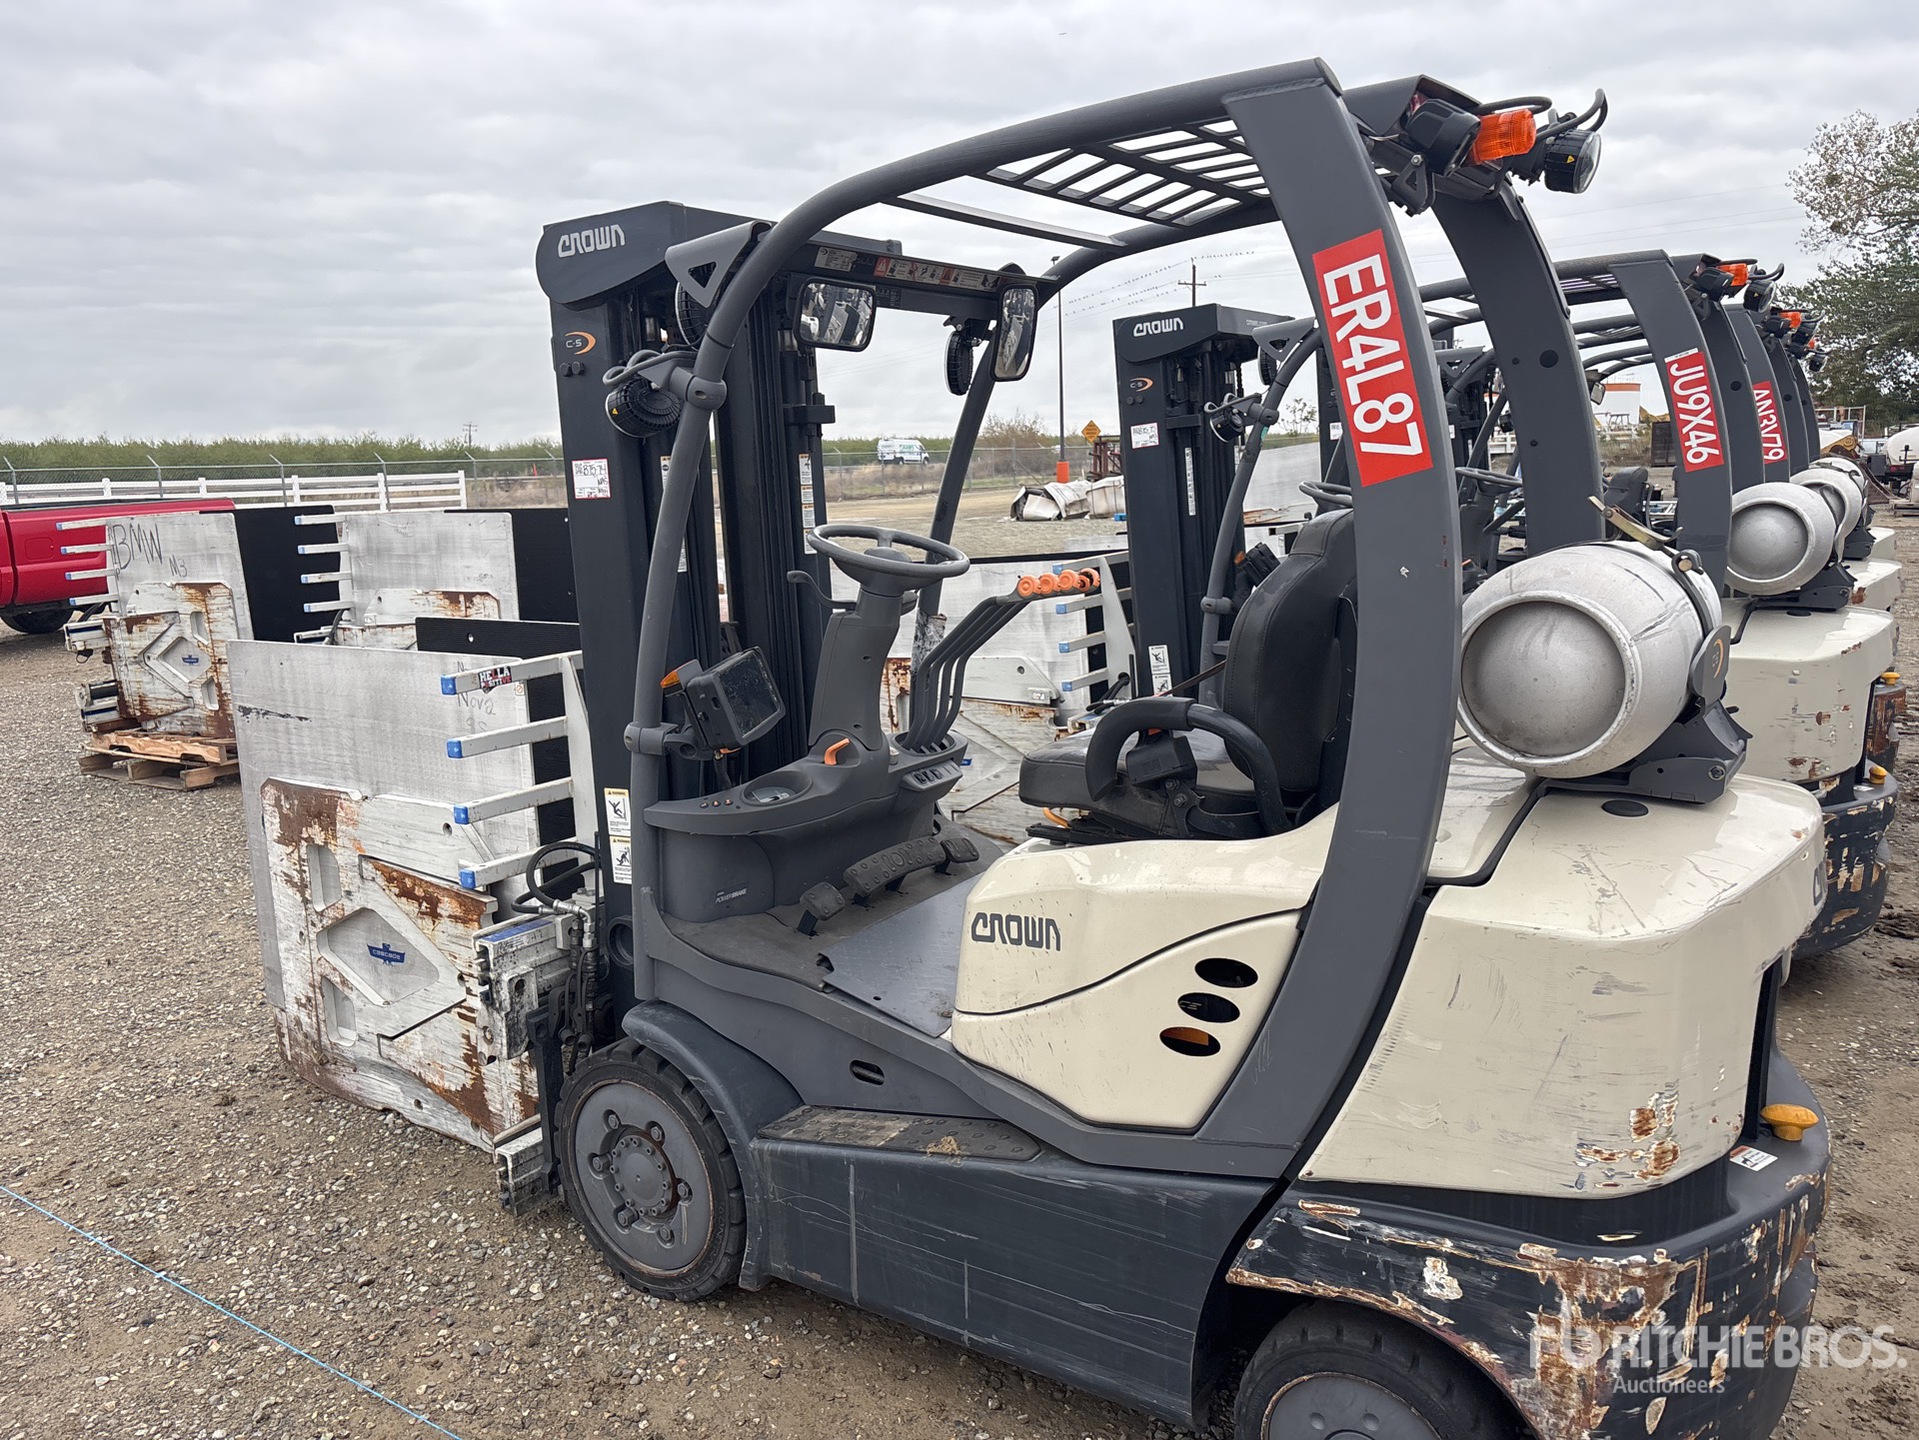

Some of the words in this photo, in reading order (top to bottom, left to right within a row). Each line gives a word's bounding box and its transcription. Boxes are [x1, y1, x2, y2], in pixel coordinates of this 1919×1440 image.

[557, 224, 626, 258] CROWN
[1133, 317, 1184, 337] CROWN
[1322, 253, 1423, 456] ER4L87
[1669, 362, 1720, 464] JU9X46
[1753, 389, 1785, 461] AN3V79
[112, 522, 163, 570] BMW
[168, 554, 188, 578] M3
[479, 667, 510, 682] HELLA
[970, 911, 1062, 952] CROWN
[372, 949, 401, 960] cascade
